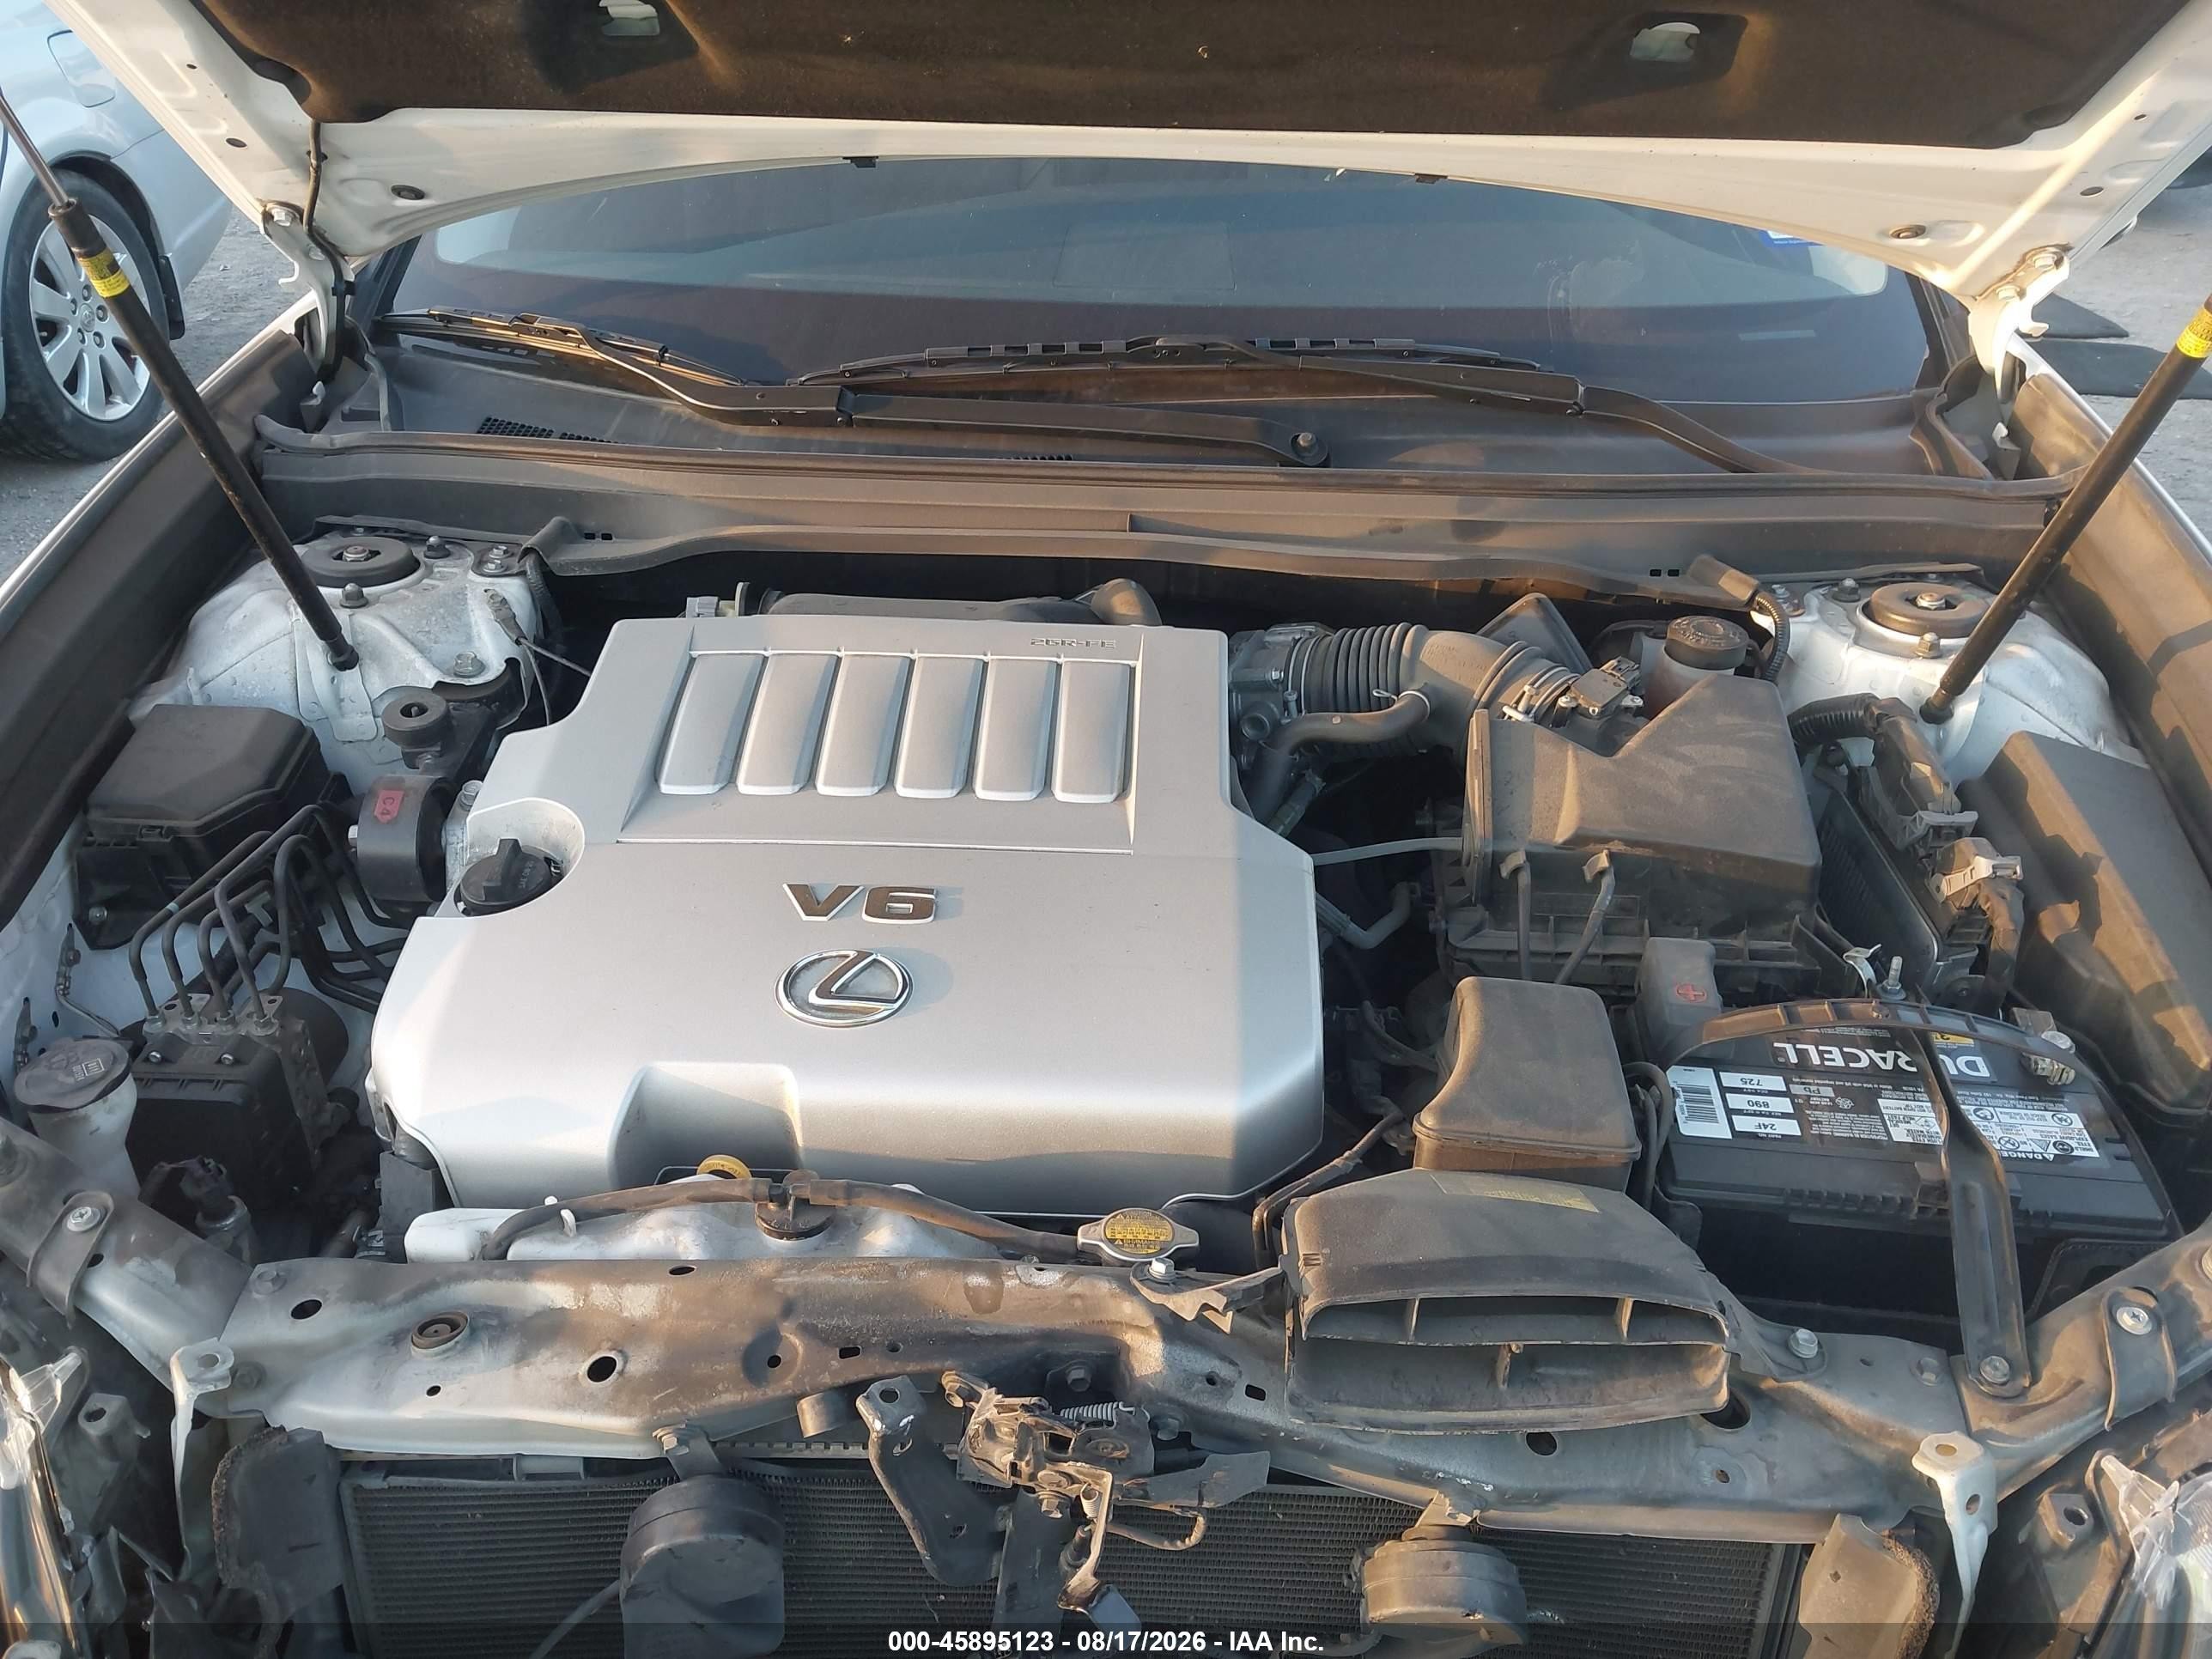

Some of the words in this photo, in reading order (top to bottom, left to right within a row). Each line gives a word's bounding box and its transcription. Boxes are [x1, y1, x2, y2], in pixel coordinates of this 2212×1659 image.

[1030, 638, 1116, 649] 2GR-FE
[781, 883, 937, 925] V6
[1740, 1078, 1763, 1086] 725
[1803, 1086, 1820, 1095] Pb
[1747, 1100, 1770, 1109] 890
[1754, 1122, 1778, 1131] 24F
[1998, 1151, 2043, 1161] DANGE
